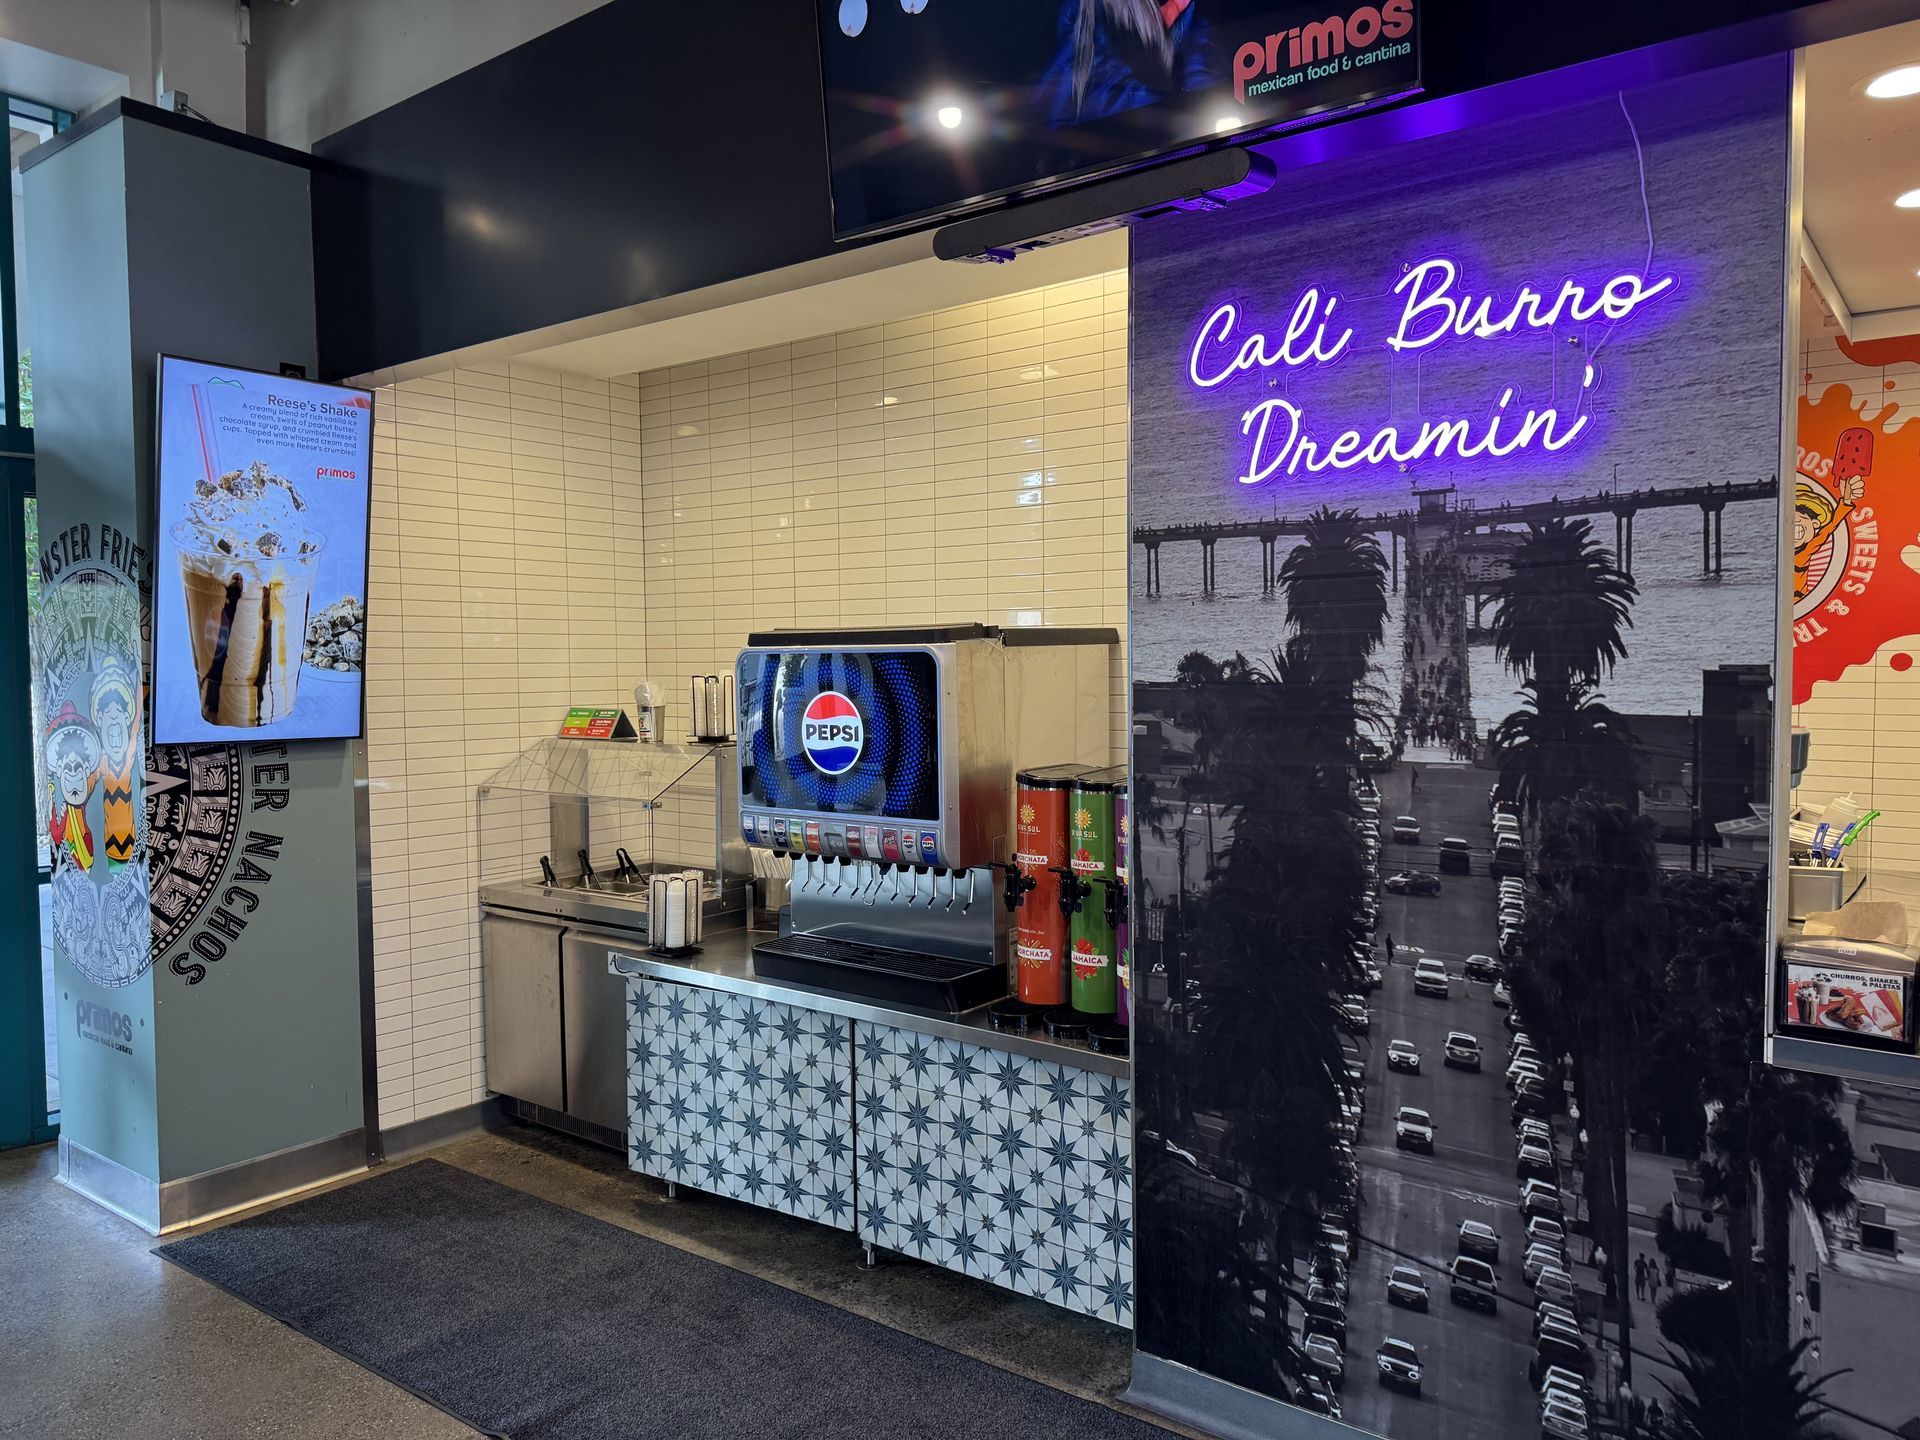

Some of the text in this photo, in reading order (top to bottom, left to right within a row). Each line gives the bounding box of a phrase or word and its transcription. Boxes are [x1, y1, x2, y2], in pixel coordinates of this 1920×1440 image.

[1233, 0, 1414, 105] primos
[1248, 41, 1411, 97] mexican food & cantina
[1189, 258, 1674, 387] Cali Burro
[249, 405, 277, 415] creamy
[279, 408, 299, 417] blend
[309, 413, 323, 421] rich
[324, 417, 347, 425] vanilla
[268, 394, 358, 418] Reese's Shake
[219, 416, 257, 427] chocolate
[258, 421, 281, 431] syrup,
[297, 427, 331, 438] crumbled
[332, 431, 357, 441] Reese's
[250, 413, 276, 422] cream,
[277, 416, 298, 425] swirls
[308, 421, 333, 430] peanut
[334, 424, 357, 434] butter,
[1238, 363, 1594, 485] Dreamin'
[222, 425, 243, 433] cups.
[245, 426, 271, 437] Topped
[272, 431, 289, 439] with
[290, 434, 320, 443] whipped
[321, 438, 342, 447] cream
[256, 437, 275, 445] even
[296, 441, 323, 452] Reese's
[324, 447, 357, 456] crumbles!
[316, 466, 356, 480] primos
[1793, 507, 1879, 648] SWEETS & TR
[805, 723, 859, 743] PEPSI
[1072, 861, 1099, 870] JAMAICA
[169, 830, 285, 986] NACHOS
[1073, 953, 1103, 965] JAMAICA
[1830, 973, 1901, 986] CHURROS, SHAKES,
[1869, 982, 1901, 990] PALETAS
[76, 1000, 133, 1042] primos
